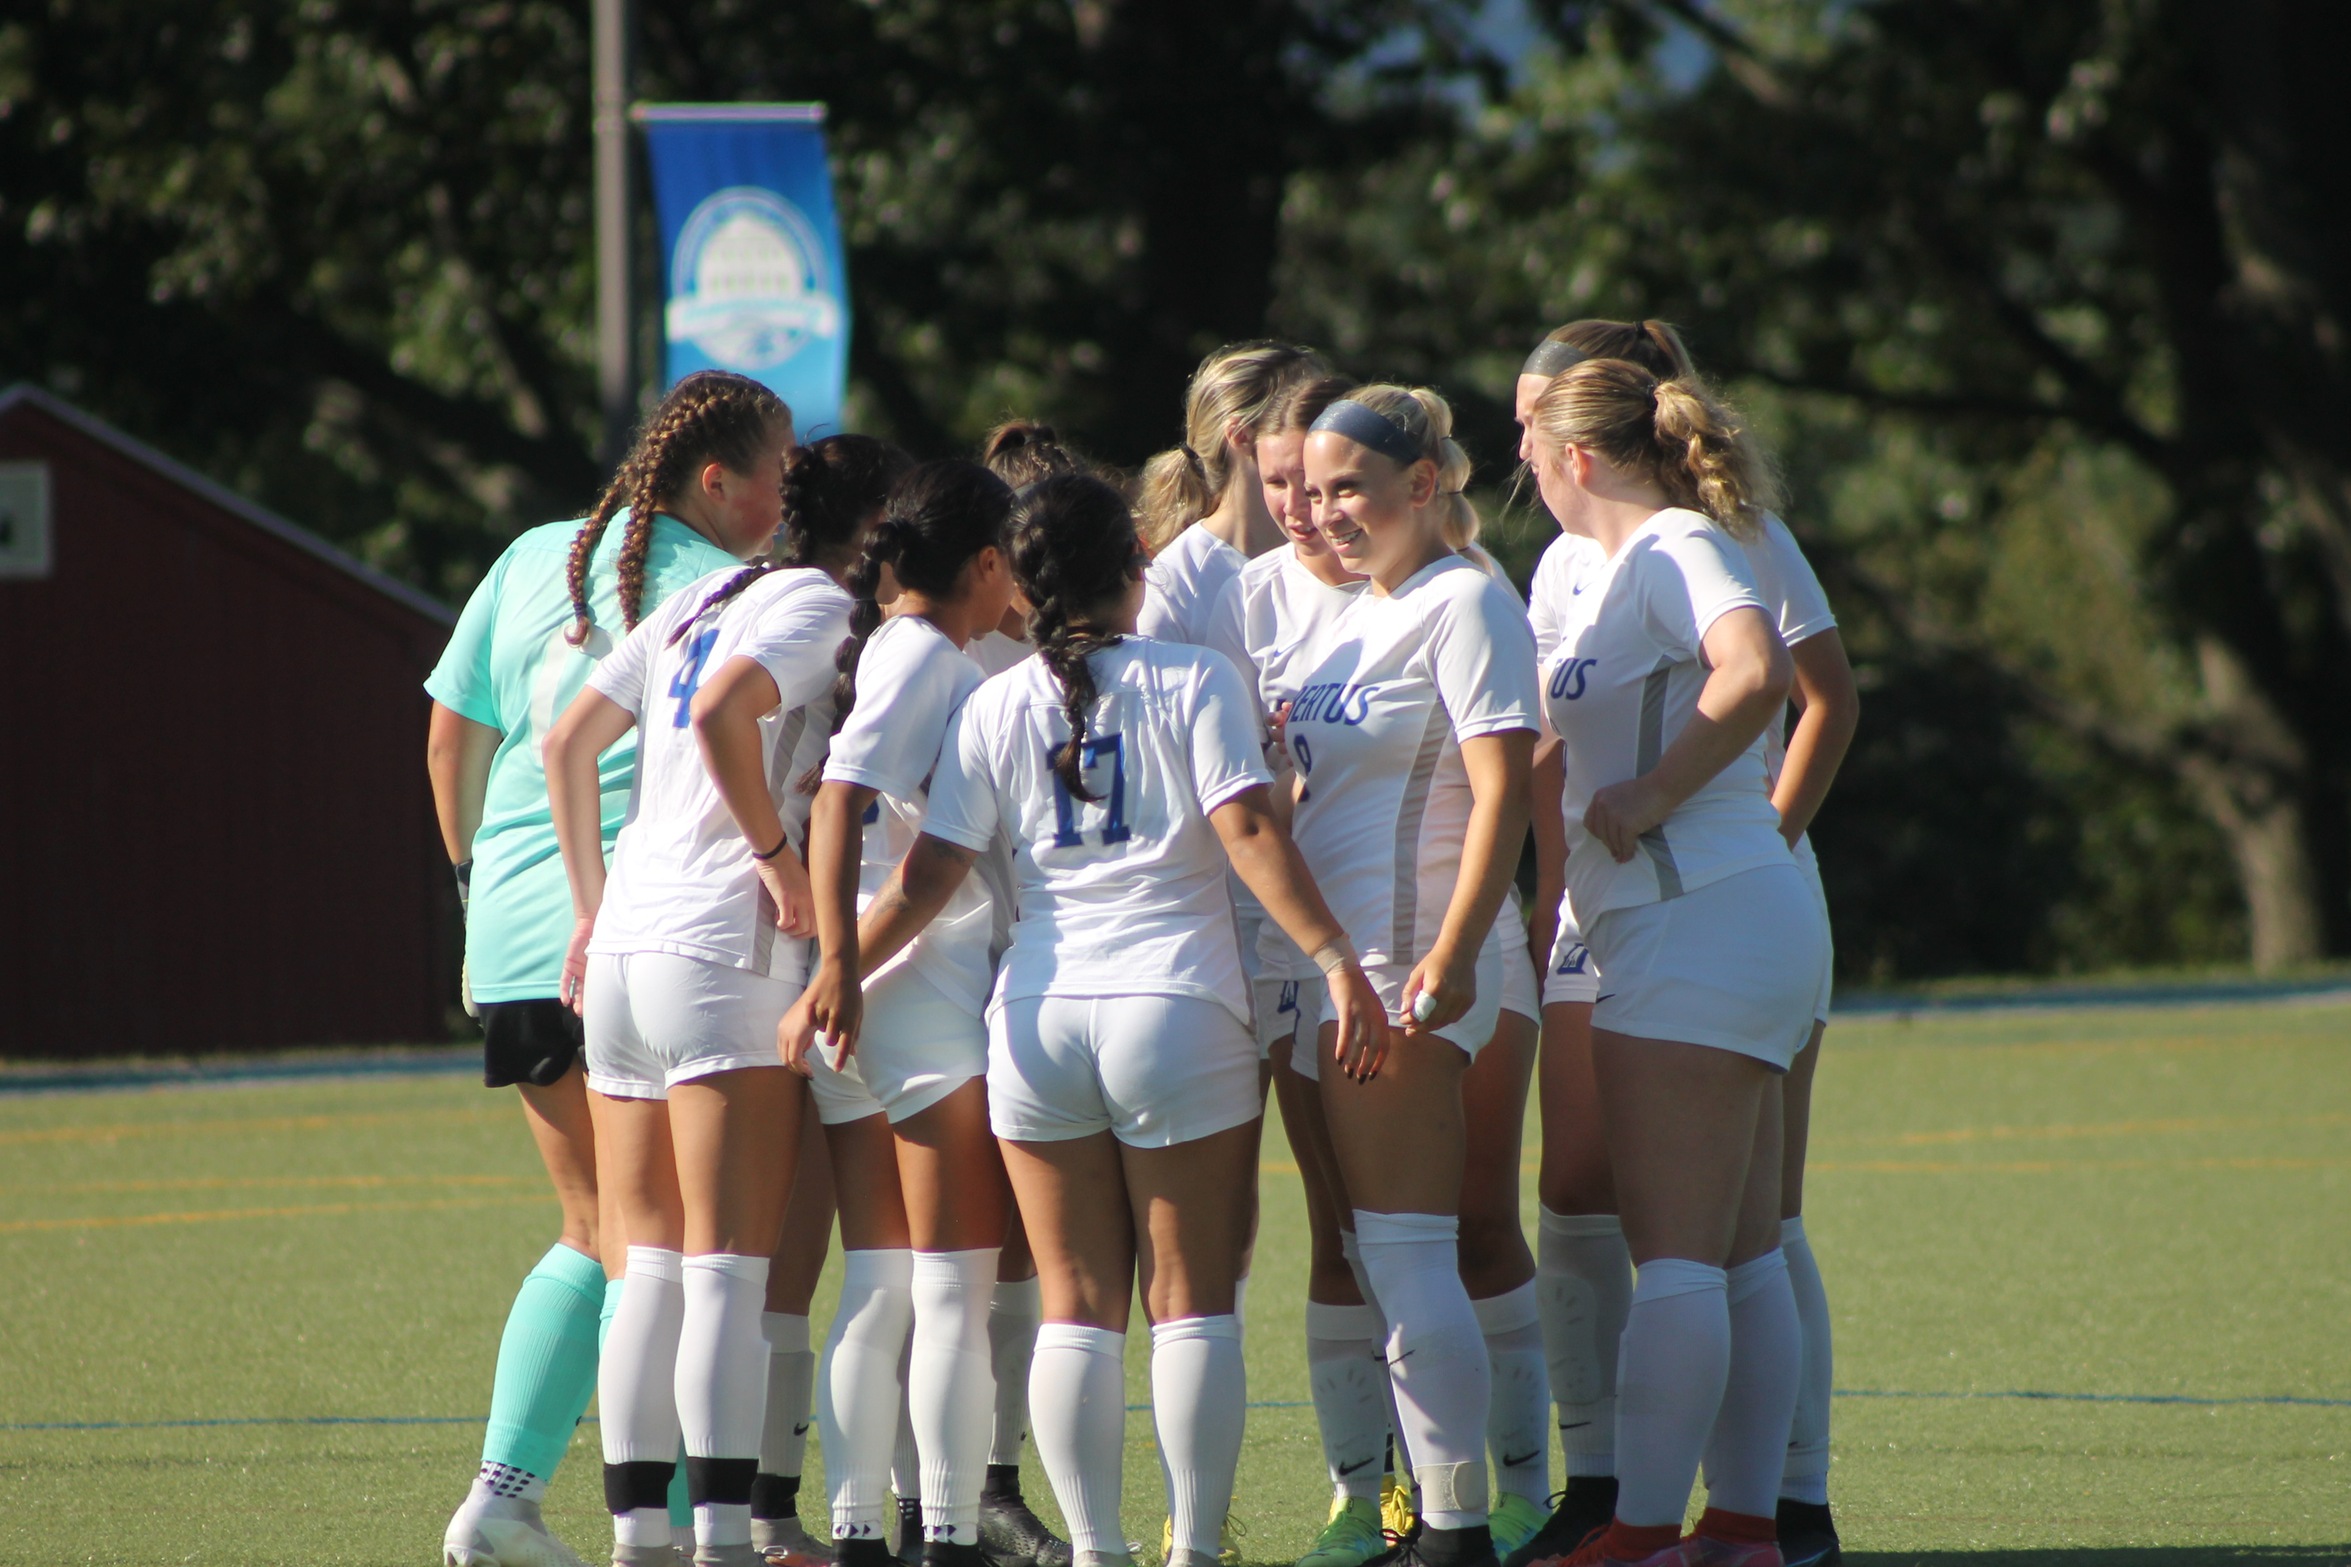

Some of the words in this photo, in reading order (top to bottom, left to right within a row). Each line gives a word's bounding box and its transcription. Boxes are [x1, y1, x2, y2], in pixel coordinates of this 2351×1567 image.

[668, 628, 720, 728] 4
[1550, 657, 1598, 700] US
[1046, 733, 1131, 849] 17
